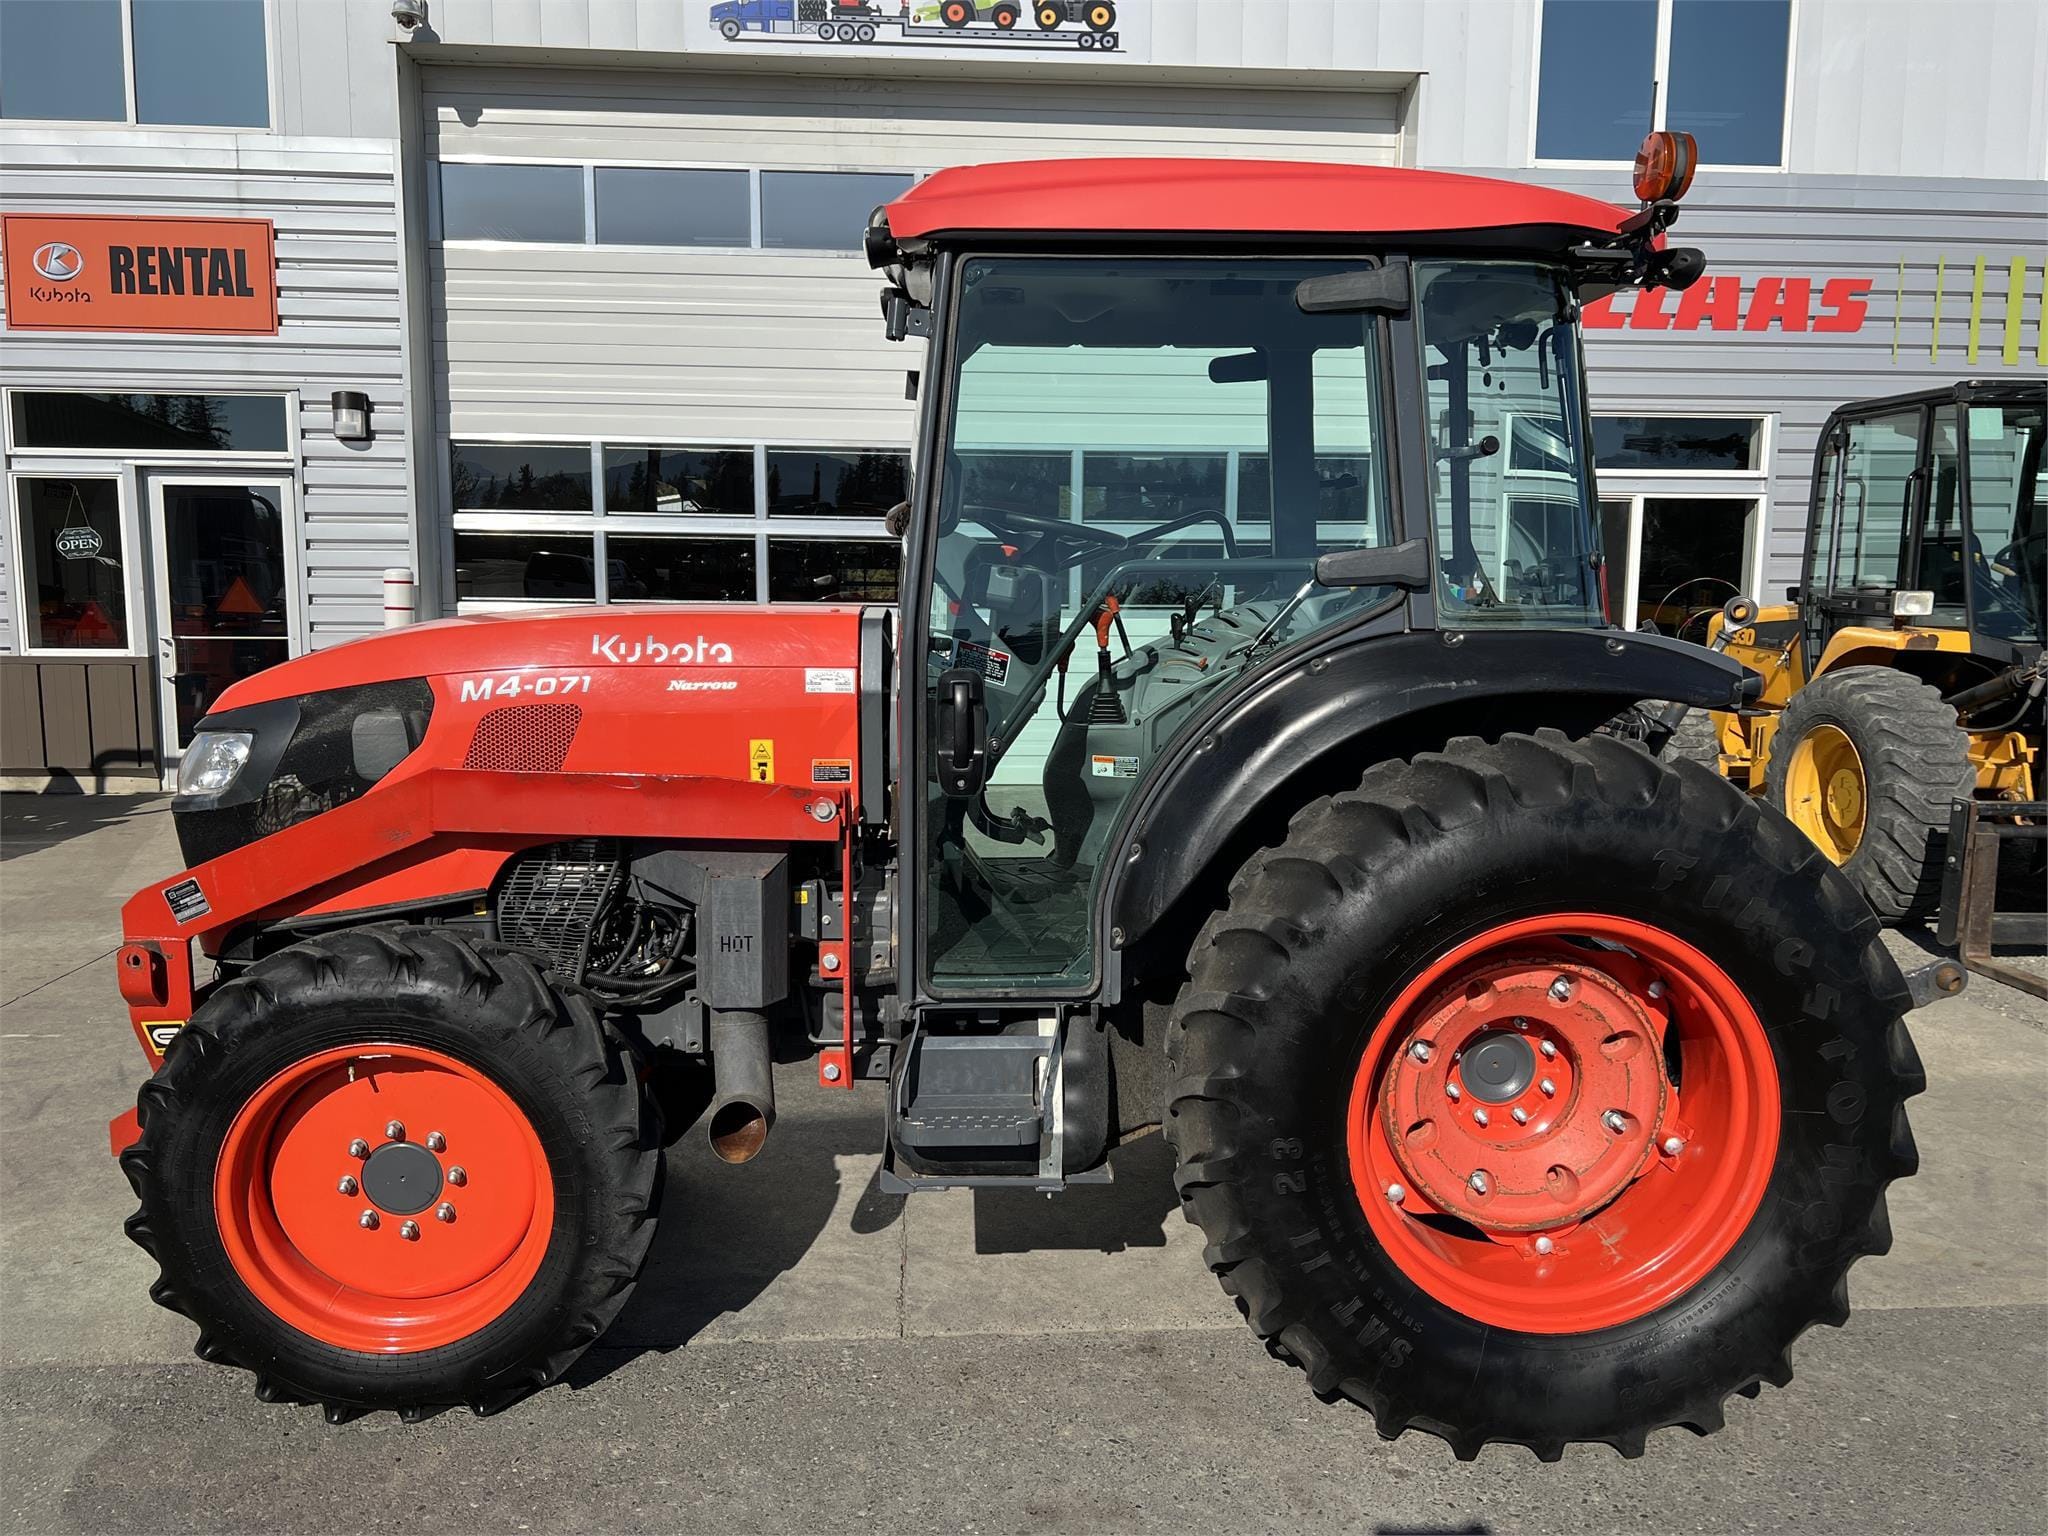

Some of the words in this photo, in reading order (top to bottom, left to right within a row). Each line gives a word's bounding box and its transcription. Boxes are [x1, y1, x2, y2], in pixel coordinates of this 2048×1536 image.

[108, 245, 254, 297] RENTAL
[30, 287, 91, 303] Kubota
[58, 538, 99, 551] OPEN
[592, 634, 733, 663] Kubota
[460, 675, 591, 703] M4-071
[666, 679, 738, 692] Narrow
[720, 935, 754, 953] HOT
[1270, 1137, 1308, 1195] 23
